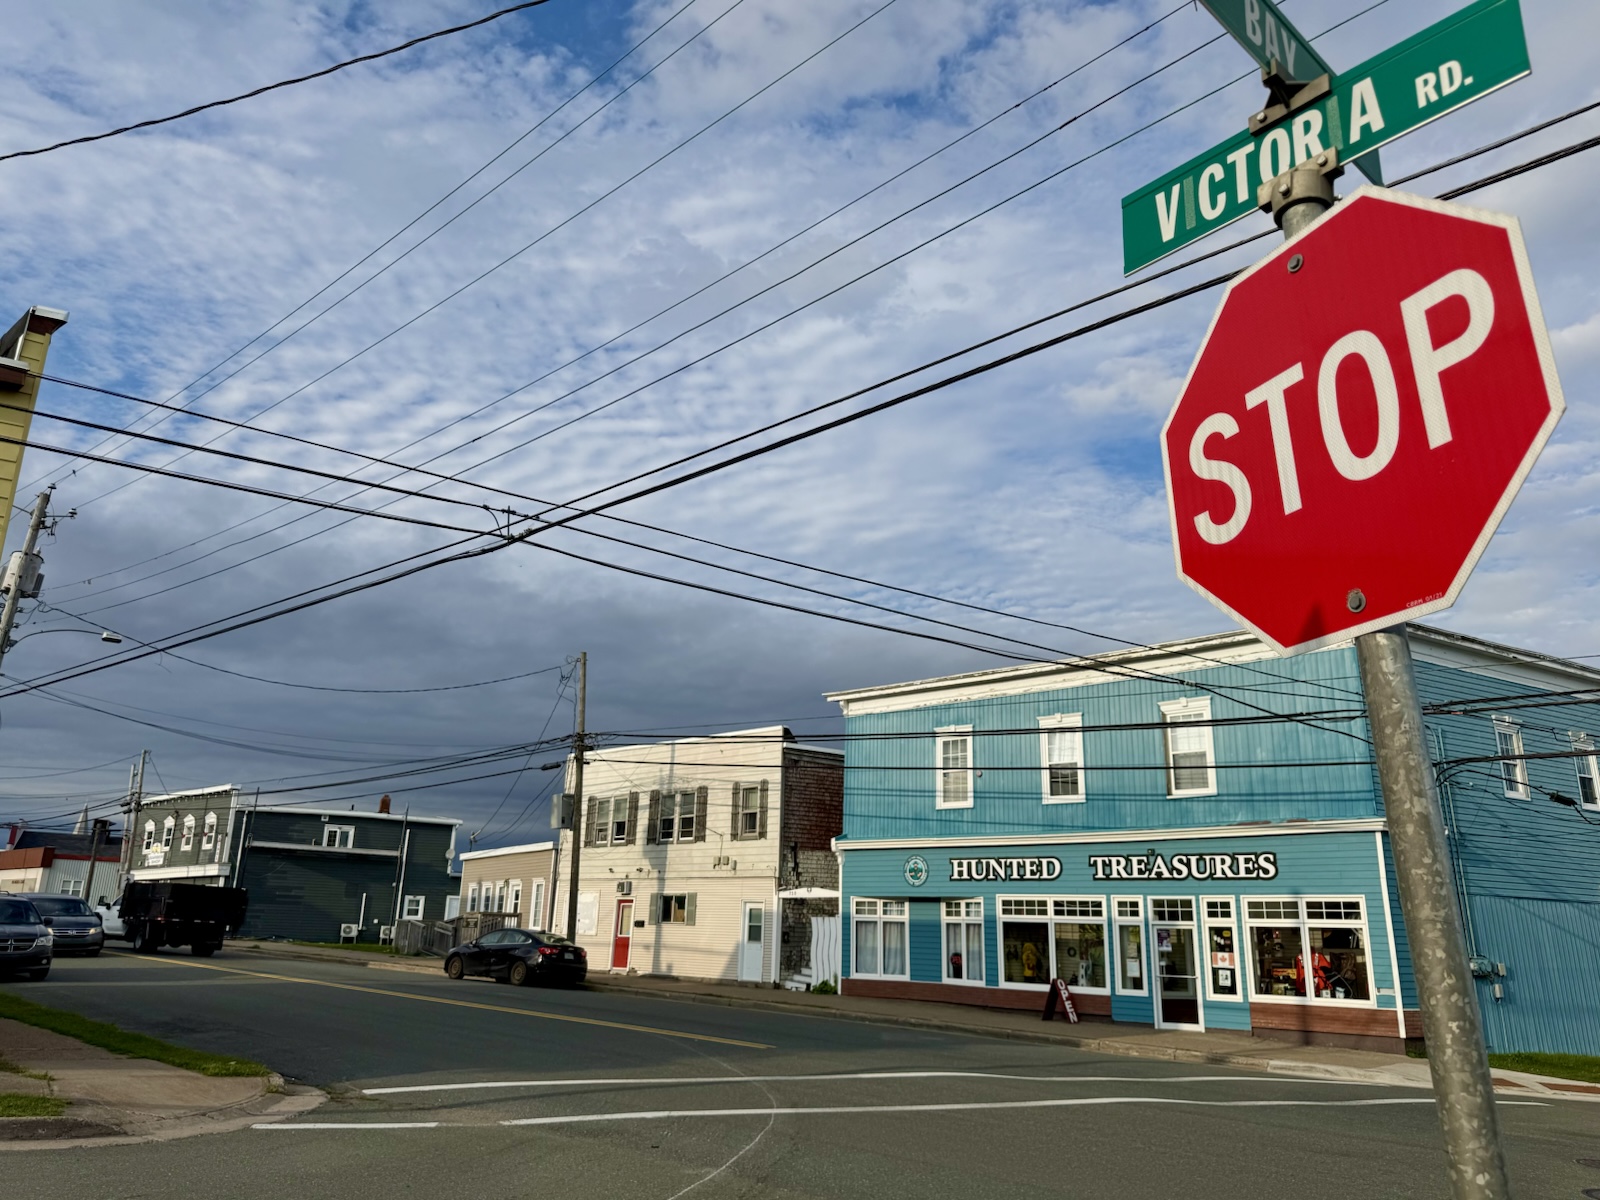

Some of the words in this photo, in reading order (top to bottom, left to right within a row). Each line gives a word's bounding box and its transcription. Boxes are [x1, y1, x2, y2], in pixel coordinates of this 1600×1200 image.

[1244, 0, 1296, 76] BAY
[1154, 77, 1385, 243] VICTORIA
[1415, 59, 1474, 109] RD.
[1188, 267, 1495, 546] STOP
[950, 857, 1062, 880] HUNTED
[1089, 852, 1277, 880] TREASURES
[1057, 978, 1079, 1024] OPEN
